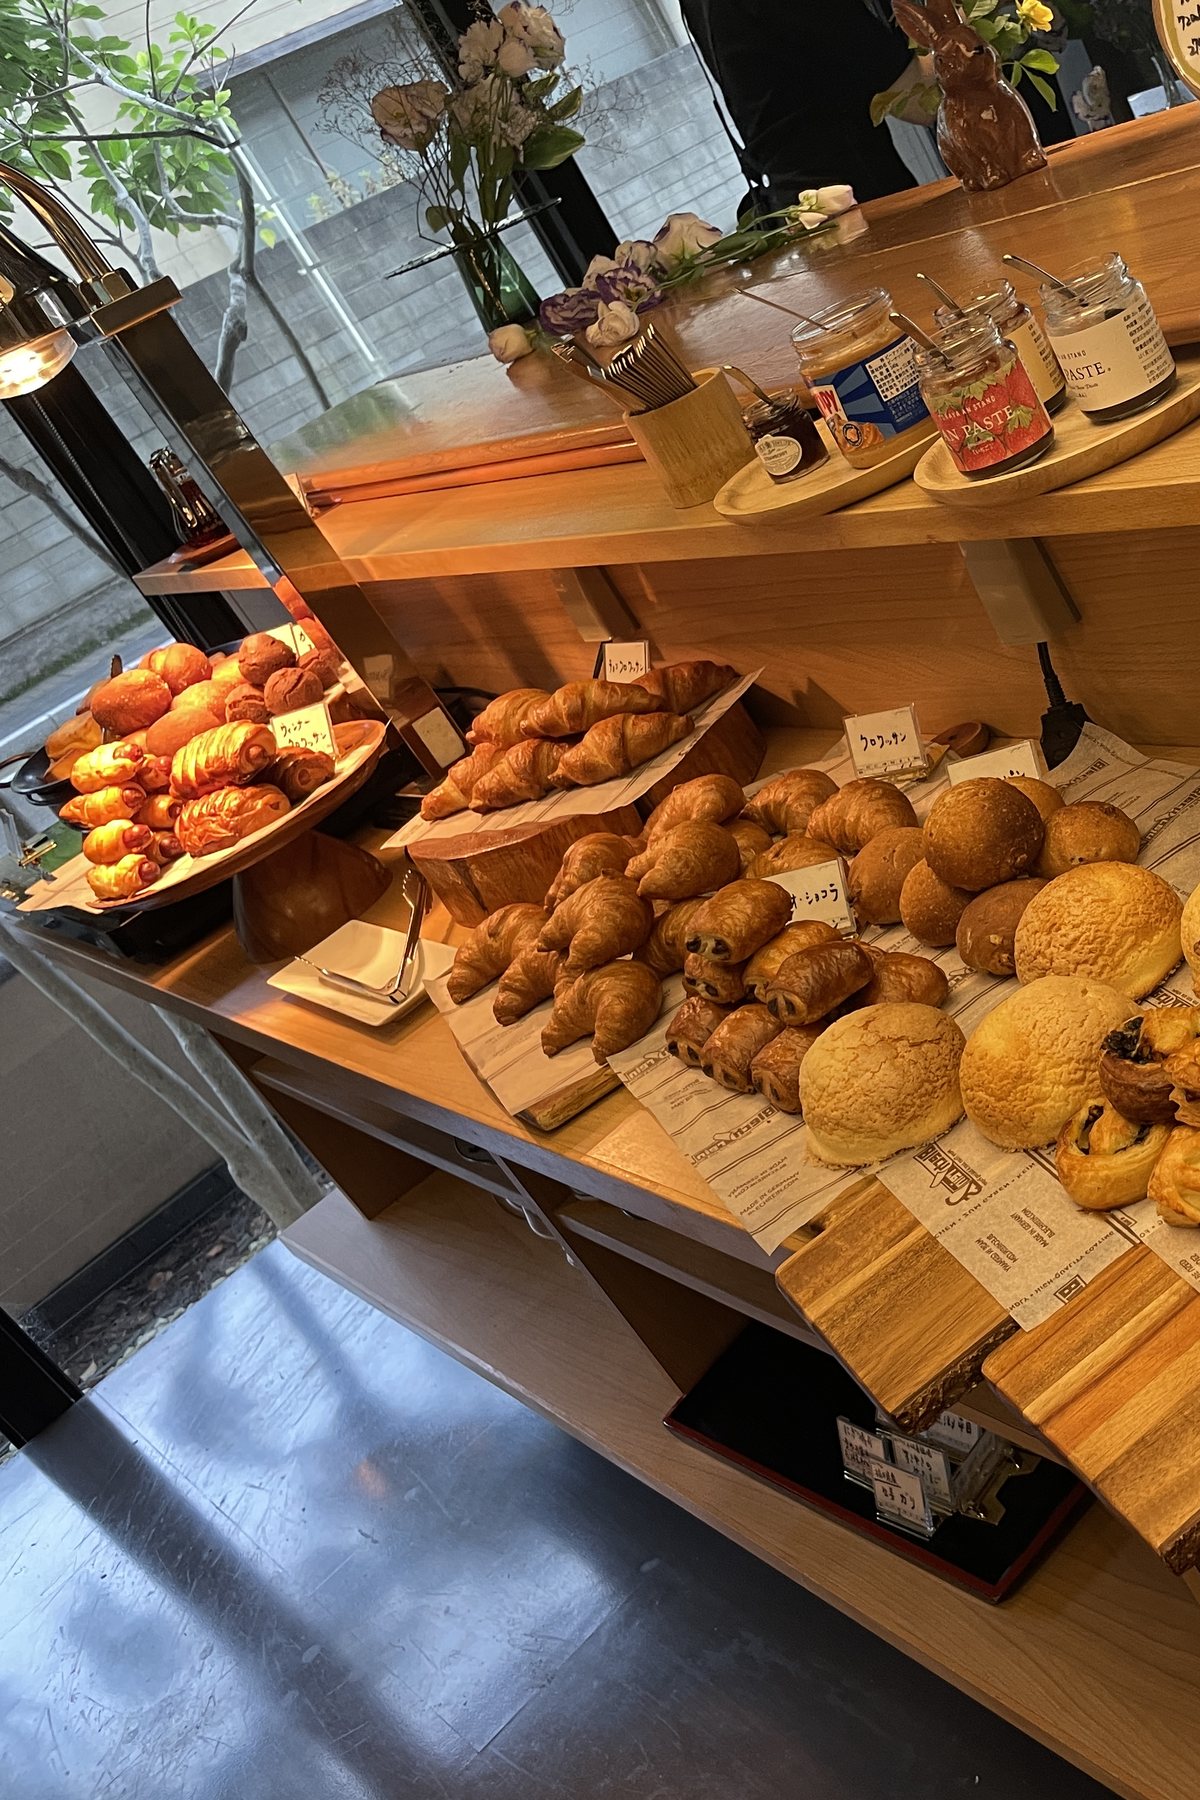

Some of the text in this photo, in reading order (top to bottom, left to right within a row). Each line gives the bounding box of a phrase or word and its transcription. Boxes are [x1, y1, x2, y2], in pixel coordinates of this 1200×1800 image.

[961, 406, 1014, 437] PASTE
[860, 731, 906, 752] クロワッサン
